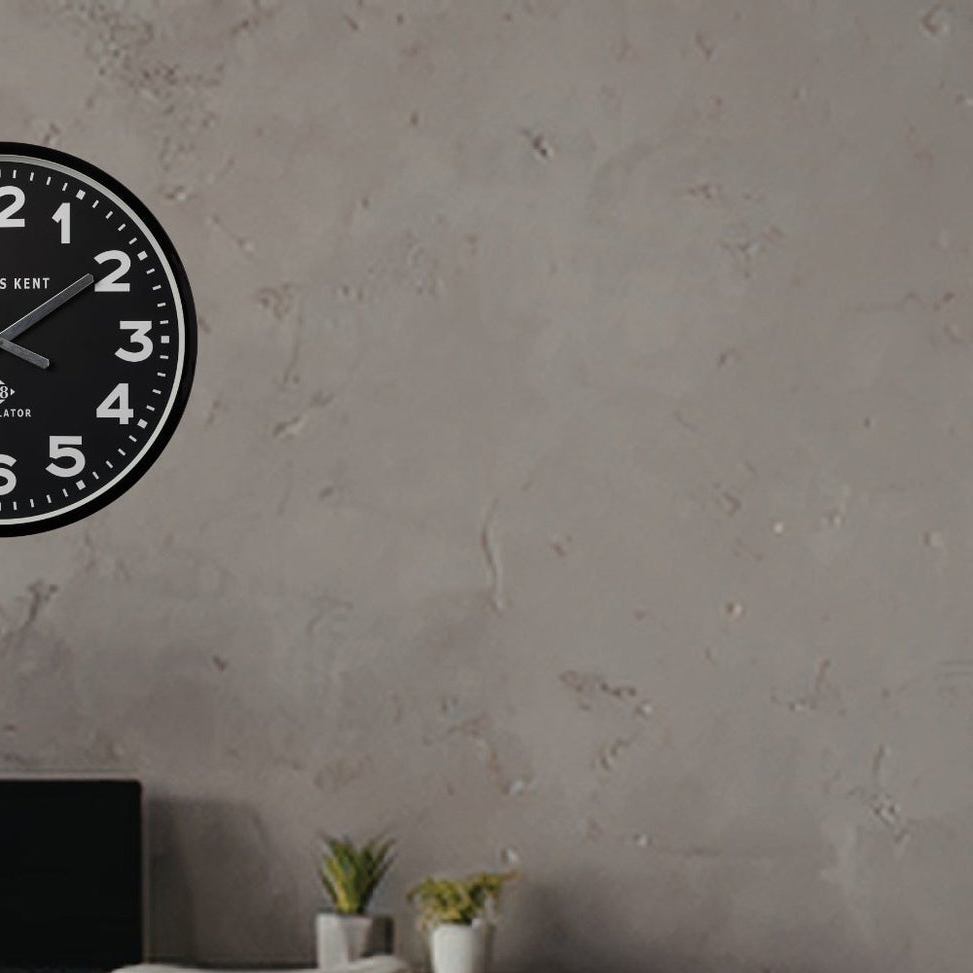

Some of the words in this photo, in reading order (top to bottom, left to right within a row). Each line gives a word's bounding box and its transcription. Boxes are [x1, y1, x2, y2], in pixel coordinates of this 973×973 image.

[52, 203, 70, 243] 1
[14, 278, 50, 289] KENT
[94, 250, 130, 291] 2
[115, 321, 153, 362] 3
[97, 383, 133, 424] 4
[46, 436, 85, 477] 5
